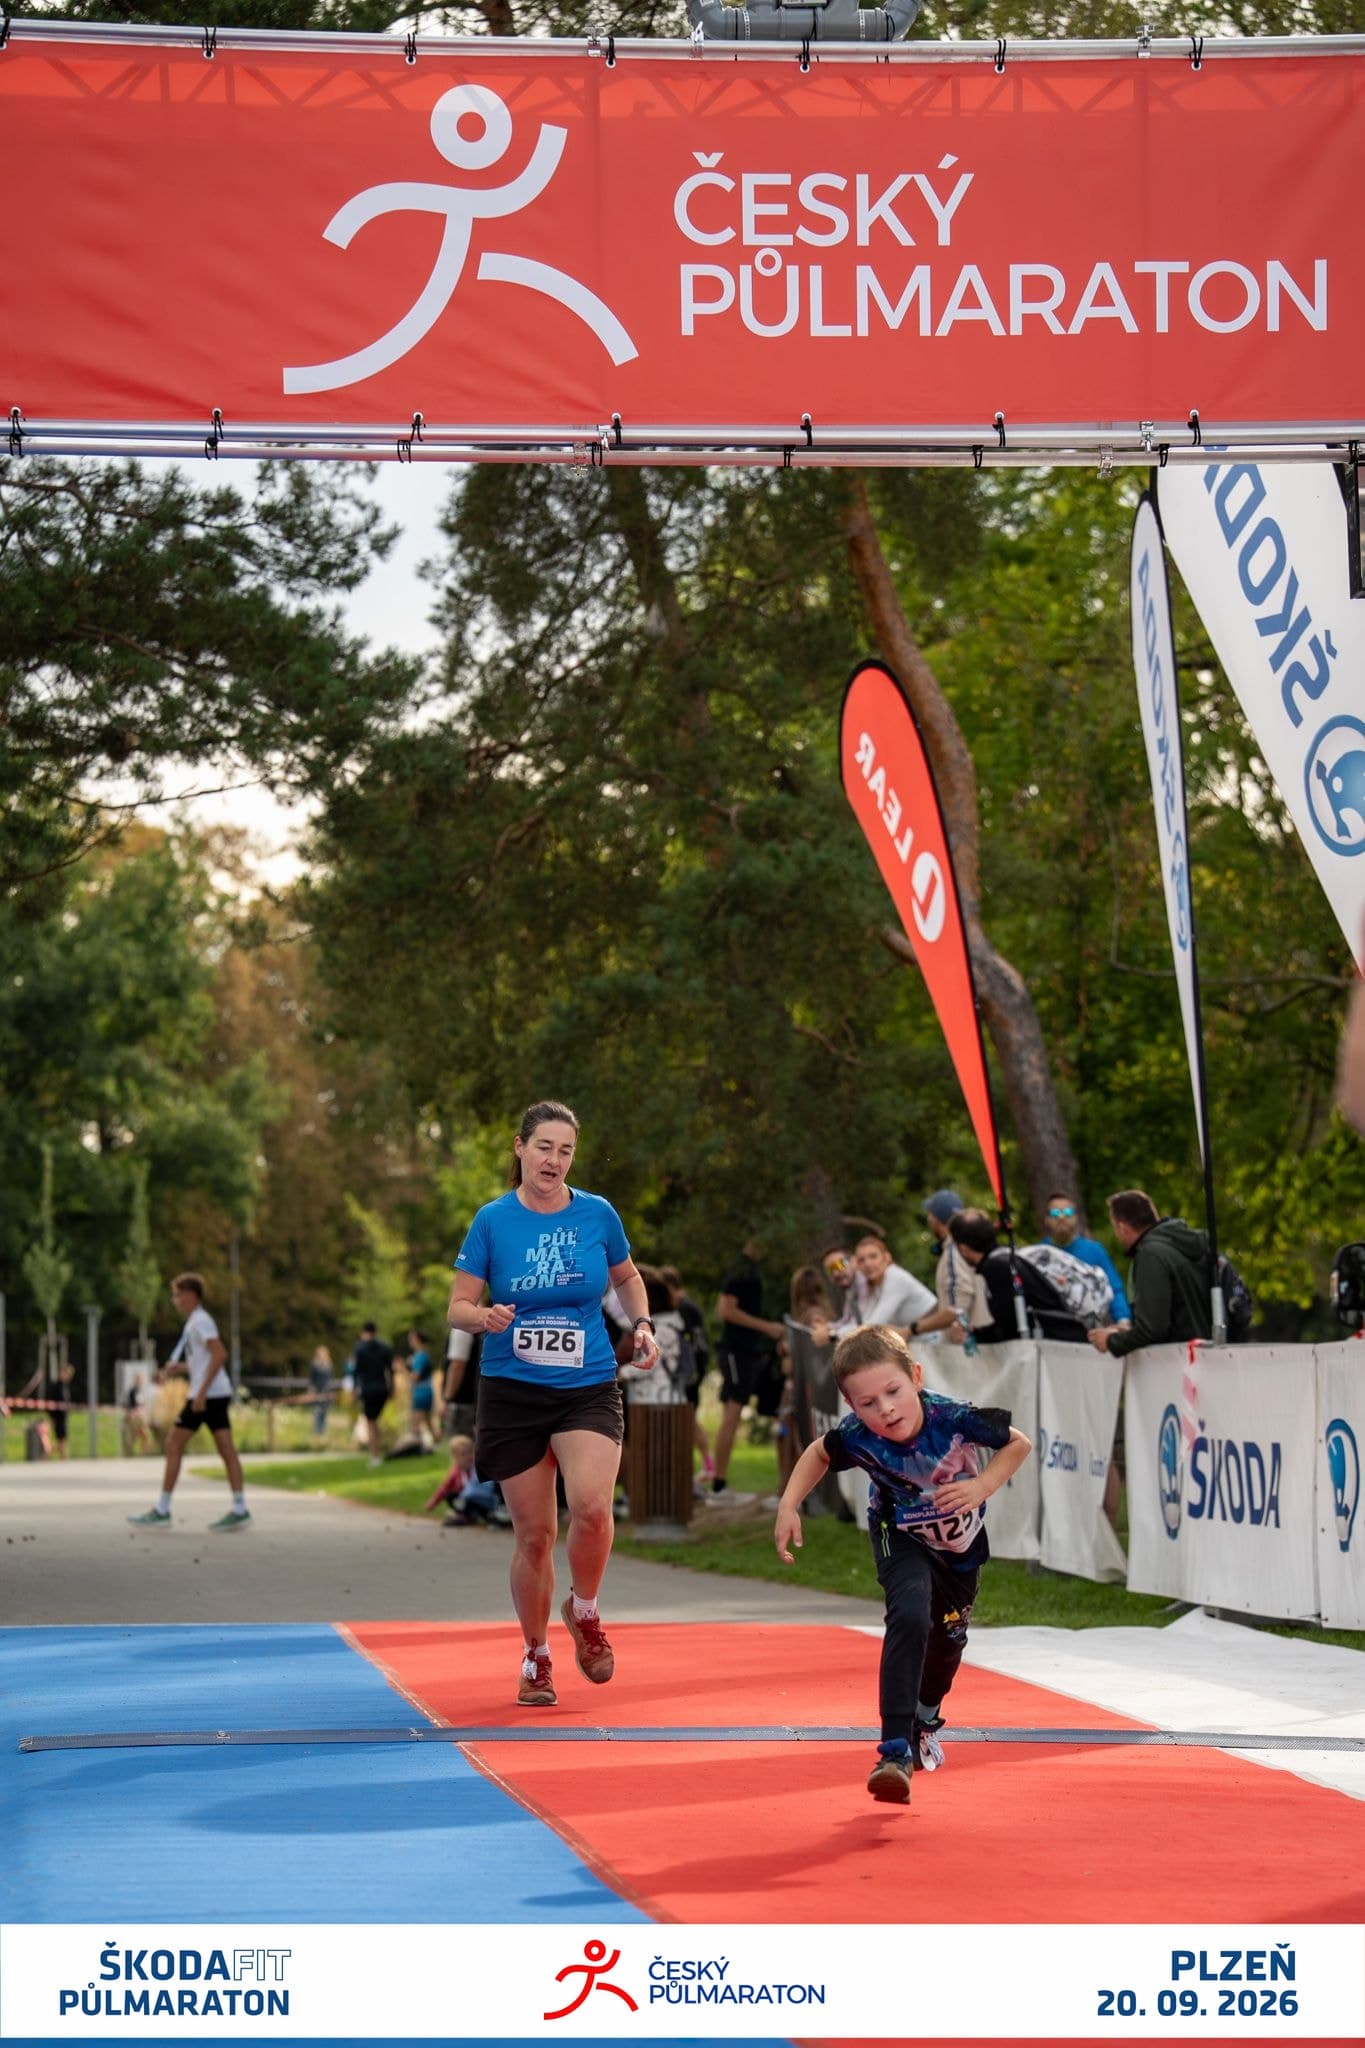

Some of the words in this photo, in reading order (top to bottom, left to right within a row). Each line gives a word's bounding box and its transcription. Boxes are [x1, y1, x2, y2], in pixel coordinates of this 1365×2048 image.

[673, 152, 975, 247] ČESKÝ
[679, 247, 1328, 337] PŮLMARATON
[537, 1227, 577, 1248] PŮL
[525, 1246, 562, 1263] MA
[535, 1260, 566, 1277] RA
[510, 1273, 556, 1292] TON
[517, 1329, 576, 1353] 5126
[1187, 1417, 1281, 1528] ŠKODA
